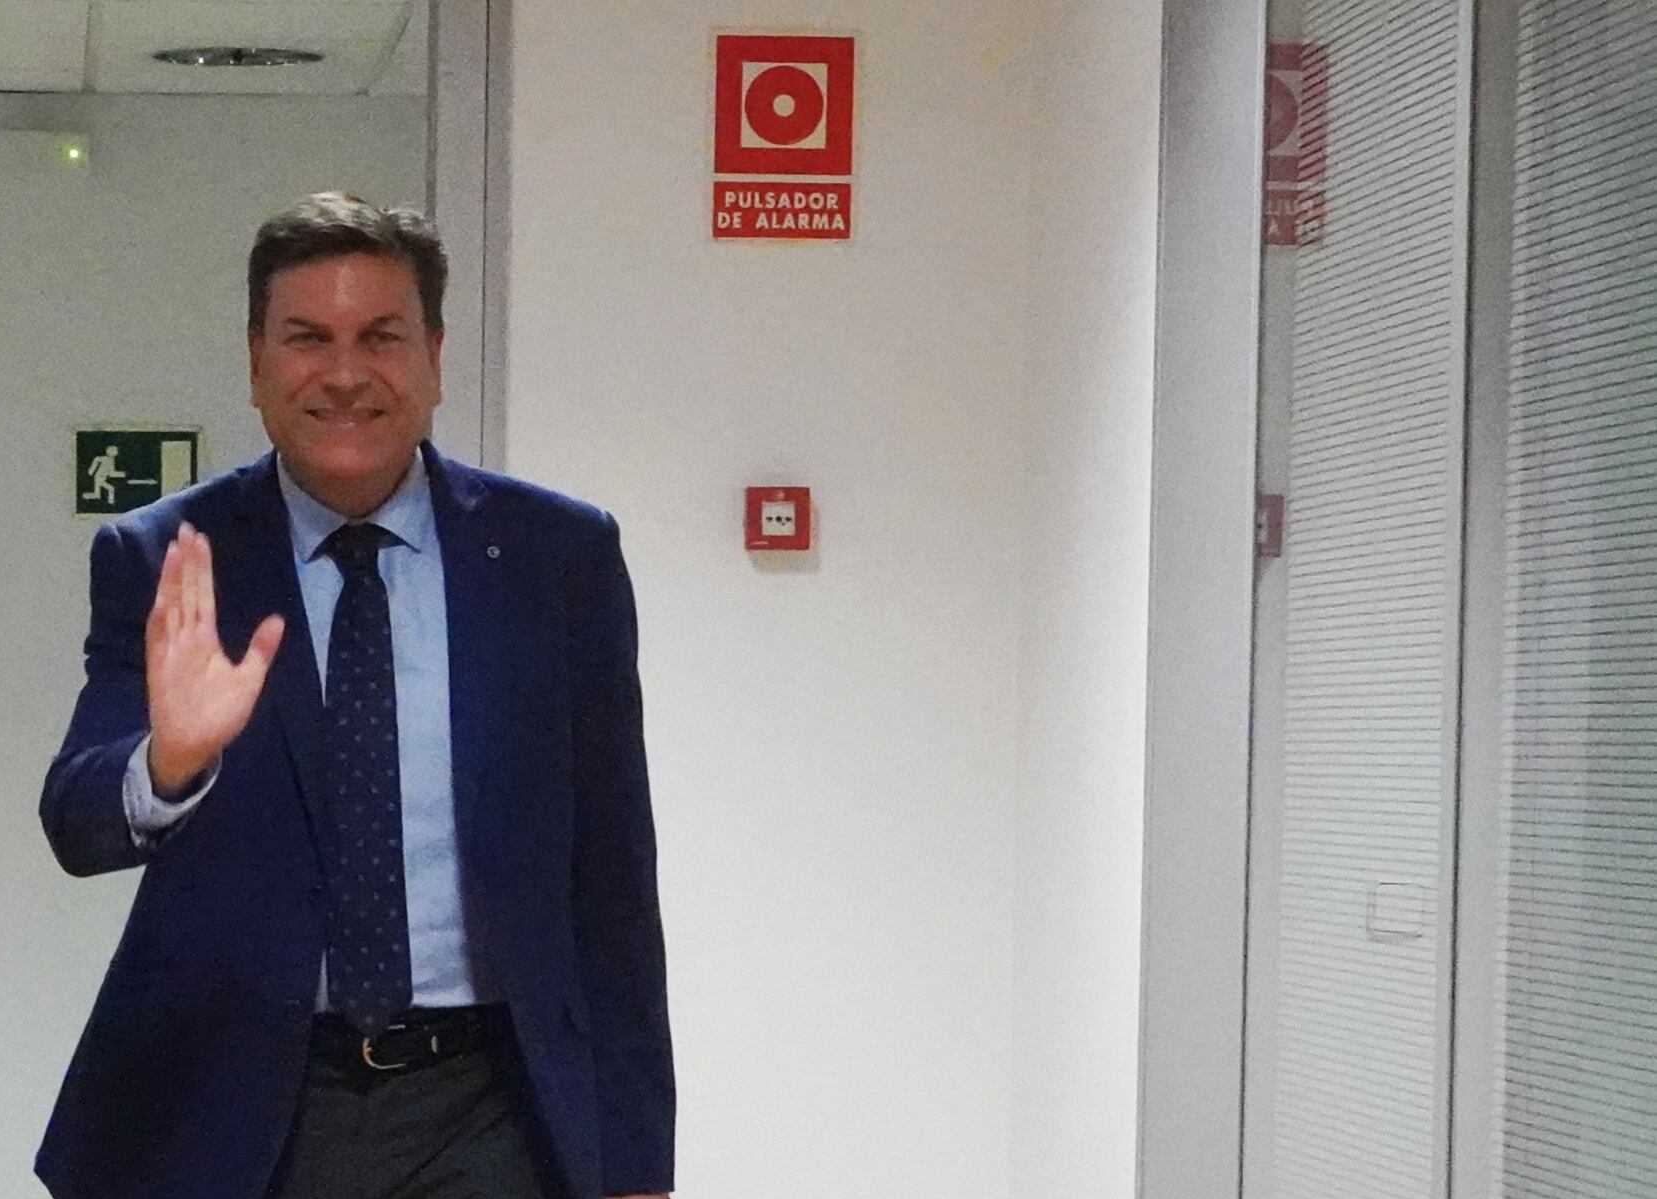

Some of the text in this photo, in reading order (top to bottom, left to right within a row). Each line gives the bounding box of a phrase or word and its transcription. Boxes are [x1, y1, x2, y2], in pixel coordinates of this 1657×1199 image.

[725, 191, 839, 209] PULSADOR
[717, 212, 845, 230] DE ALARMA
